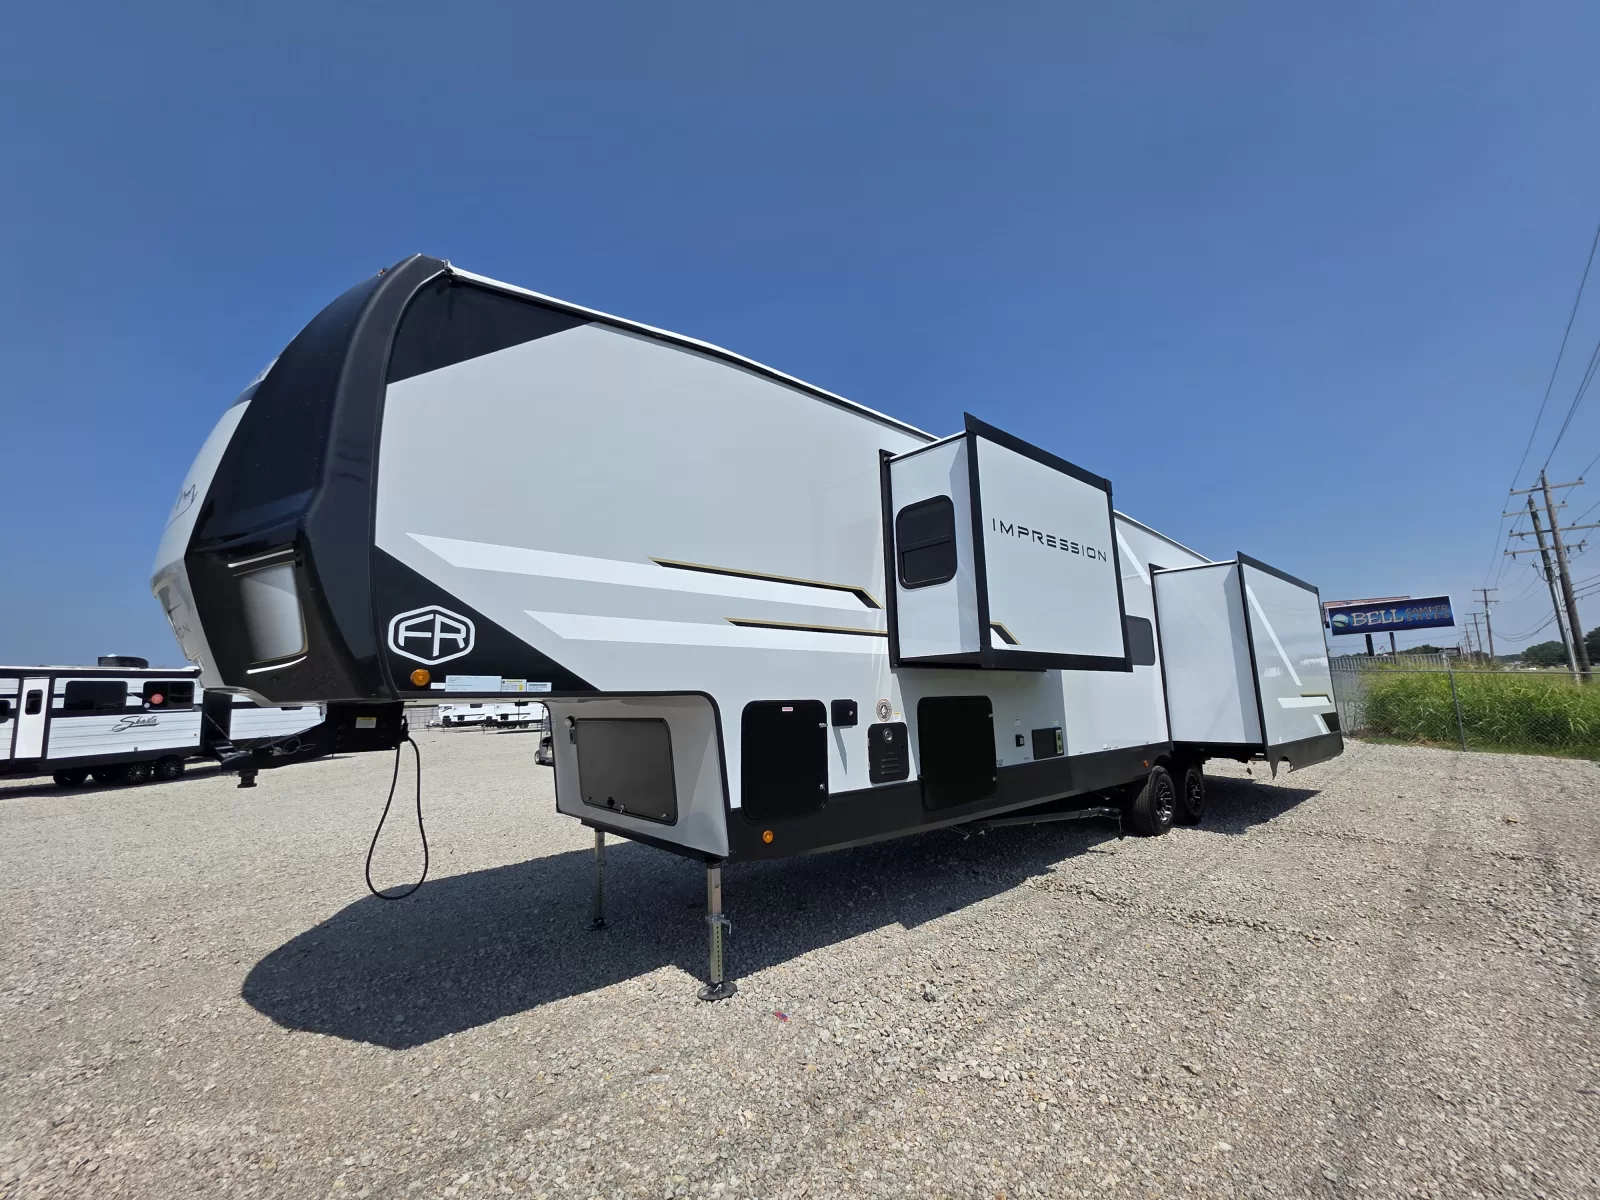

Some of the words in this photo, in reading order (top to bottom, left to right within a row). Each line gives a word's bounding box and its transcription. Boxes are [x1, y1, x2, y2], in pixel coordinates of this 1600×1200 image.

[992, 518, 1107, 562] IMPRESSION
[1351, 609, 1404, 627] BELL
[1405, 604, 1449, 616] CAMPER
[1406, 613, 1450, 622] SALES
